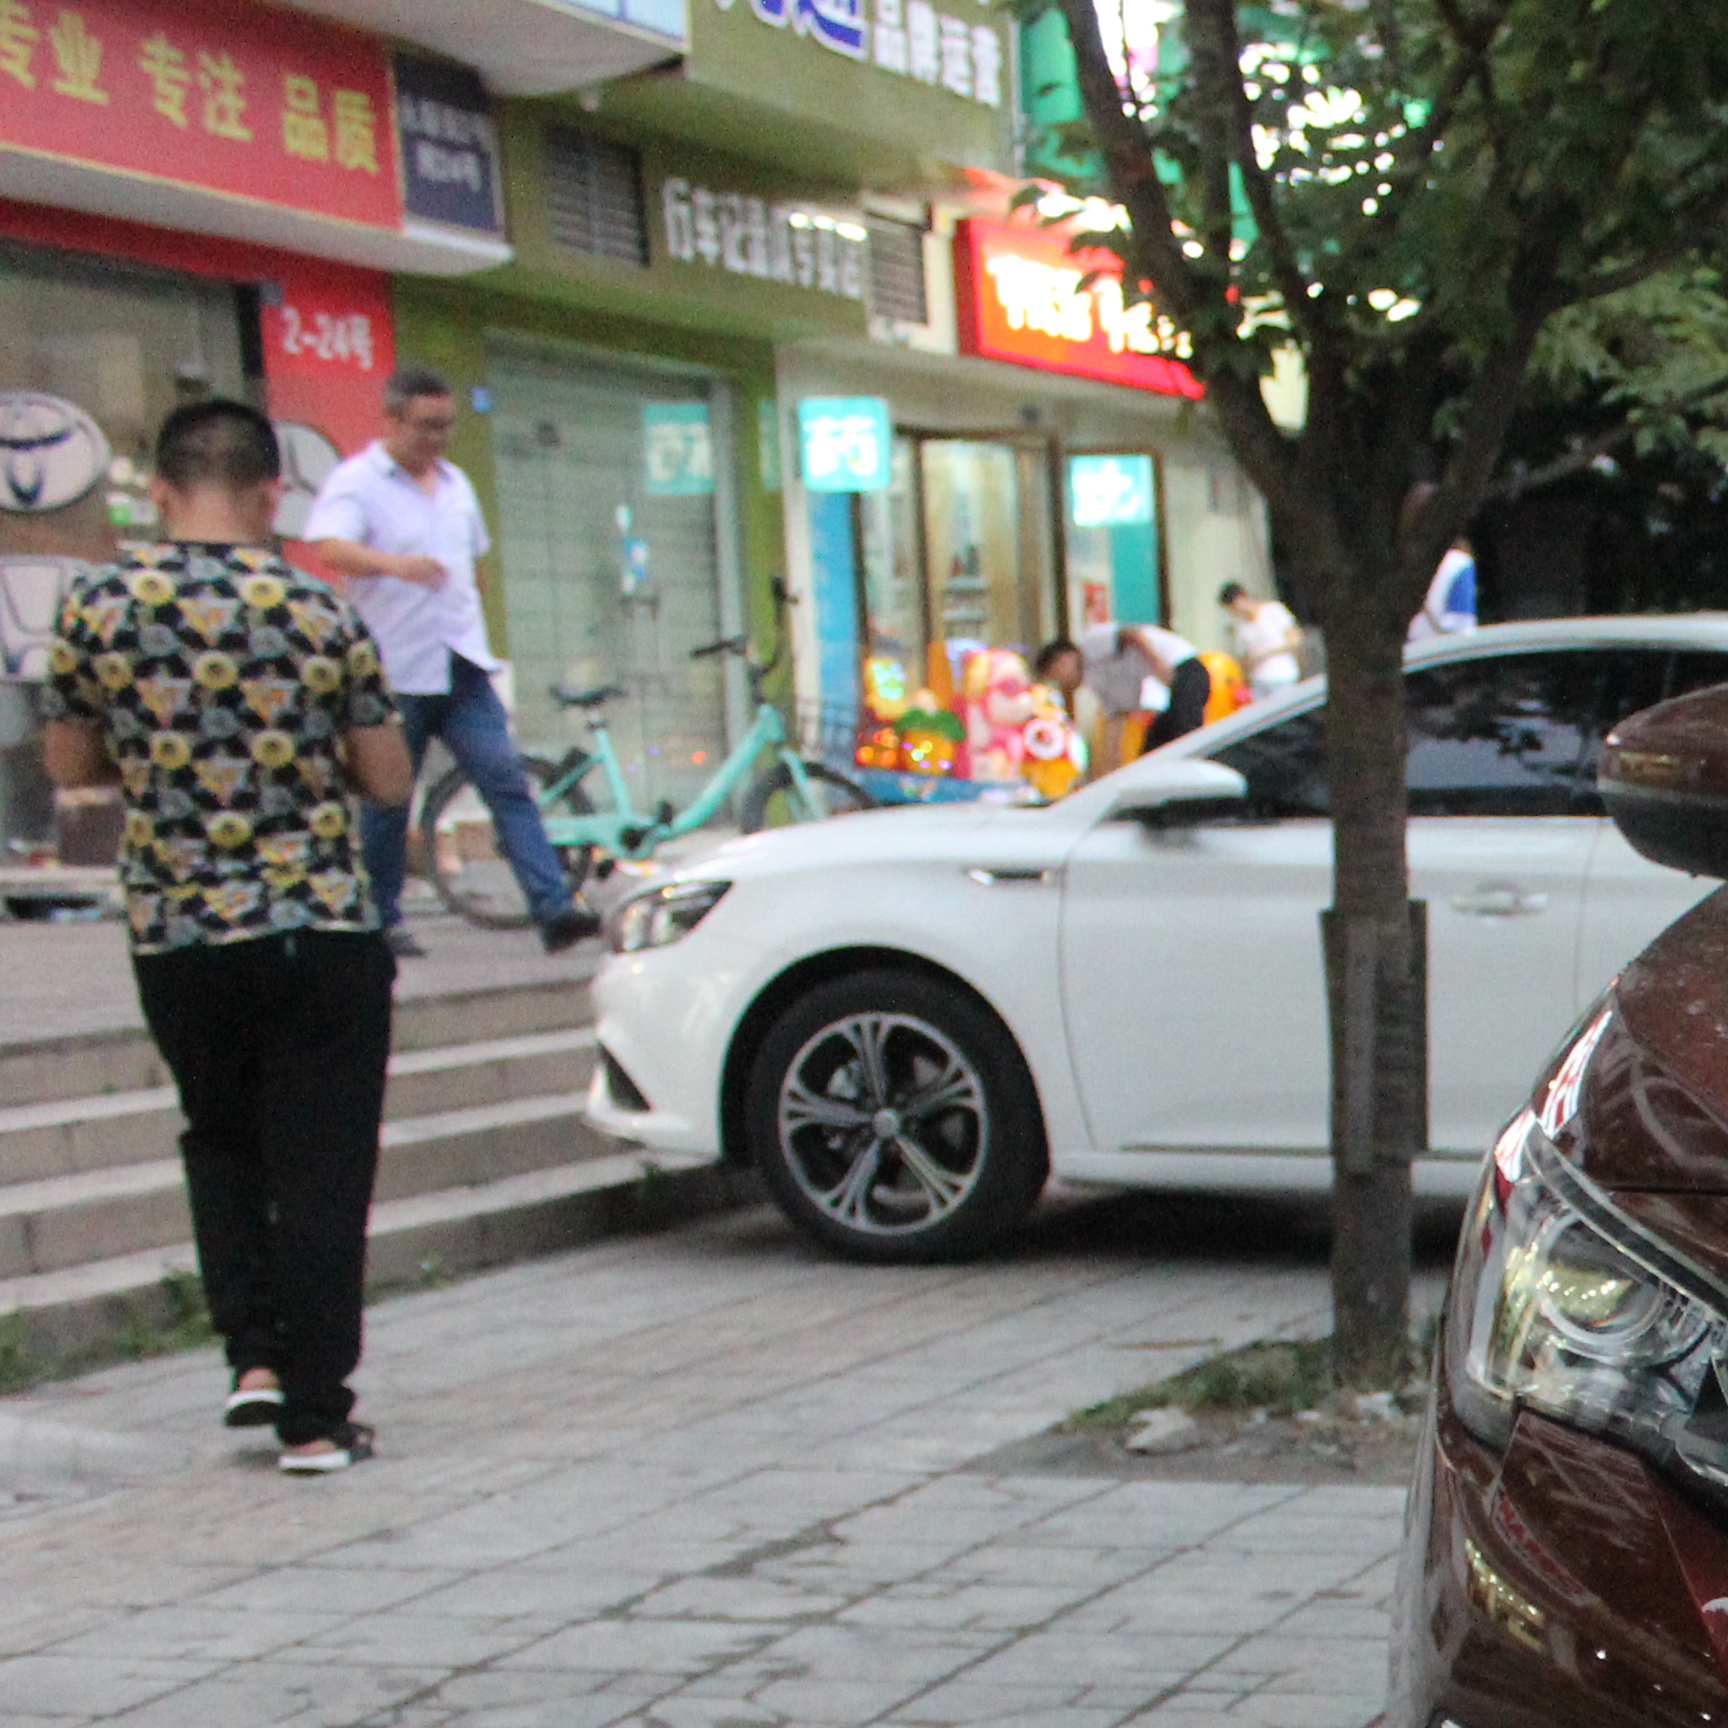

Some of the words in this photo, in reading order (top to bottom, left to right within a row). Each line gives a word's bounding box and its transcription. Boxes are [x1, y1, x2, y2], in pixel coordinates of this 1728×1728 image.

[0, 0, 109, 104] 专业
[139, 33, 253, 142] 专注
[282, 74, 380, 175] 品质
[282, 305, 373, 370] 2-24号
